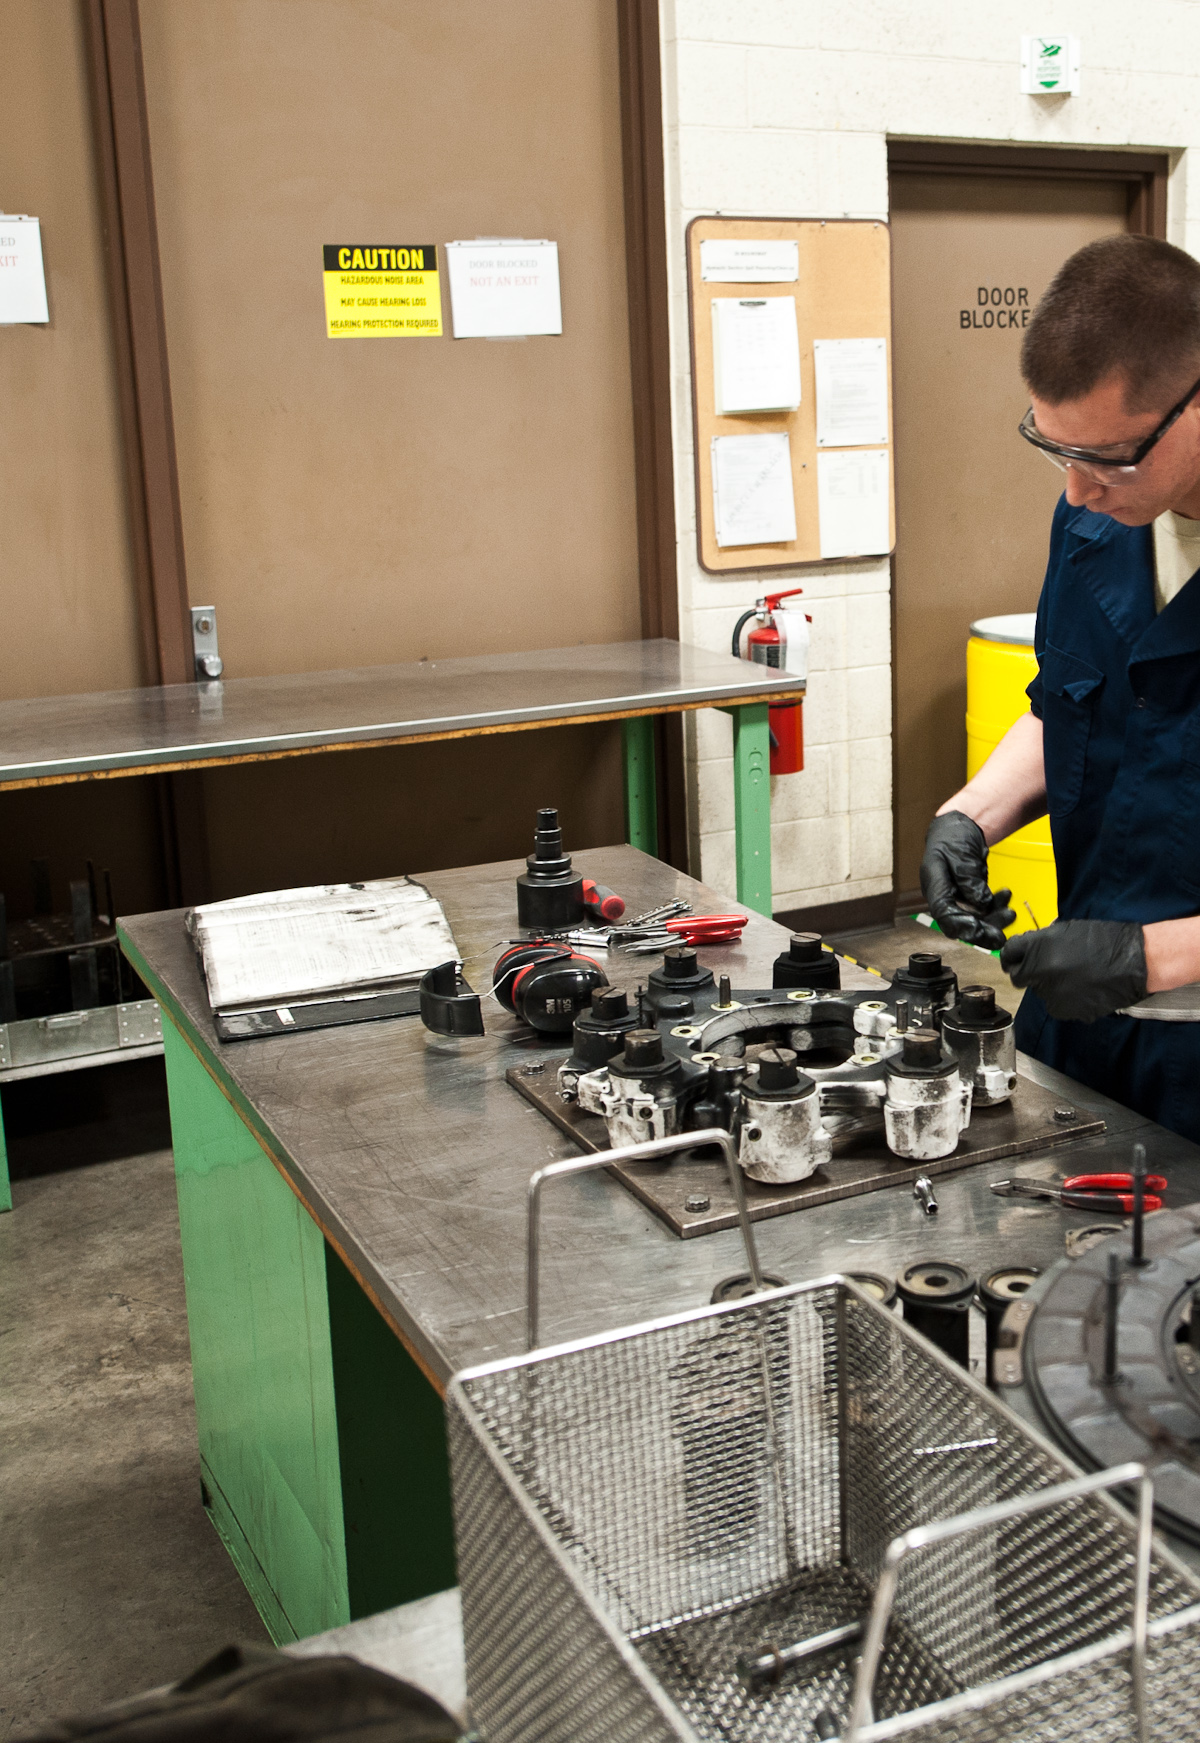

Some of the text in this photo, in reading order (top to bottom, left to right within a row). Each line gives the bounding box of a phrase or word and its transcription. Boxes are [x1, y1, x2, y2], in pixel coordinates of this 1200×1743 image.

[338, 248, 424, 270] CAUTION
[469, 260, 494, 269] DOOR
[496, 259, 538, 269] BLOCKED
[340, 275, 424, 285] HAZARDOUS NOISE AREA
[470, 275, 539, 287] NOT AN EXIT
[340, 297, 427, 307] MAY CAUSE HEARING LOSS
[977, 287, 1029, 306] DOOR
[330, 318, 439, 330] HEARING PROTECTION REQUIRED
[960, 309, 1031, 329] BLOCKE
[546, 999, 555, 1014] 3M
[563, 999, 571, 1013] 105
